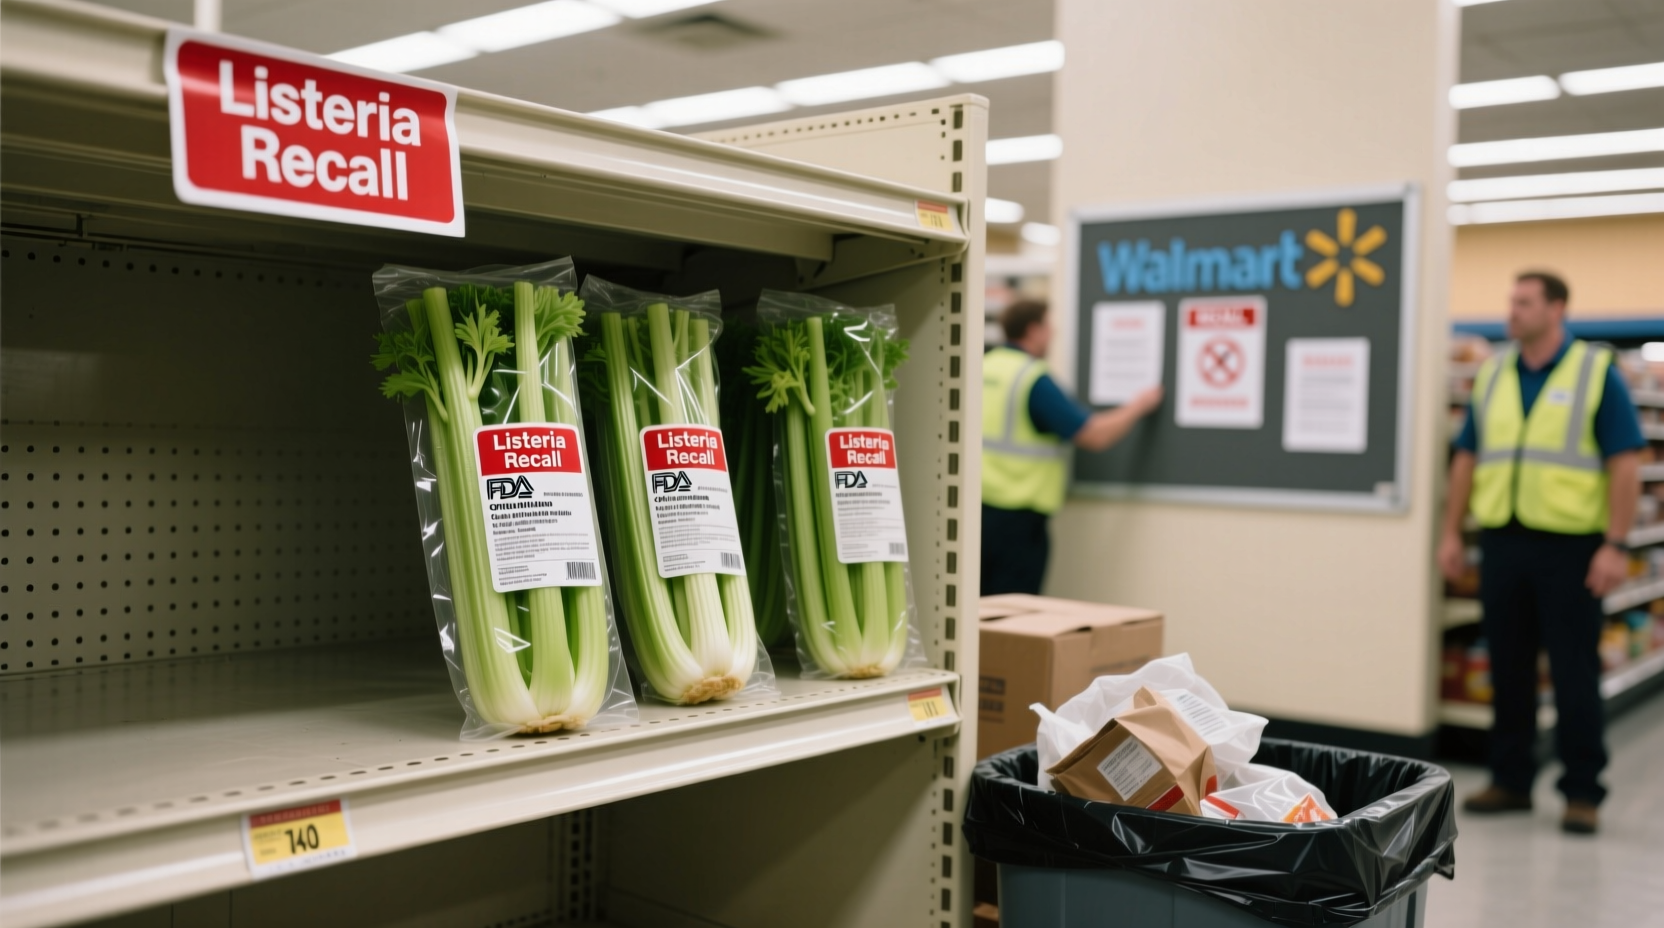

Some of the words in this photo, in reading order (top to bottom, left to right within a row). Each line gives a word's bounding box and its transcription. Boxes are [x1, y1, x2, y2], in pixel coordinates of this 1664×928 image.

[219, 59, 421, 146] Listeria
[240, 125, 408, 201] Recall
[1097, 229, 1304, 294] Walmart
[493, 431, 566, 451] Listeria
[657, 431, 718, 449] Listeria
[504, 451, 562, 468] Recall
[666, 449, 715, 465] Recall
[847, 450, 886, 465] Recall
[486, 475, 534, 500] FDA
[652, 470, 692, 494] FDA
[834, 470, 868, 489] FDA
